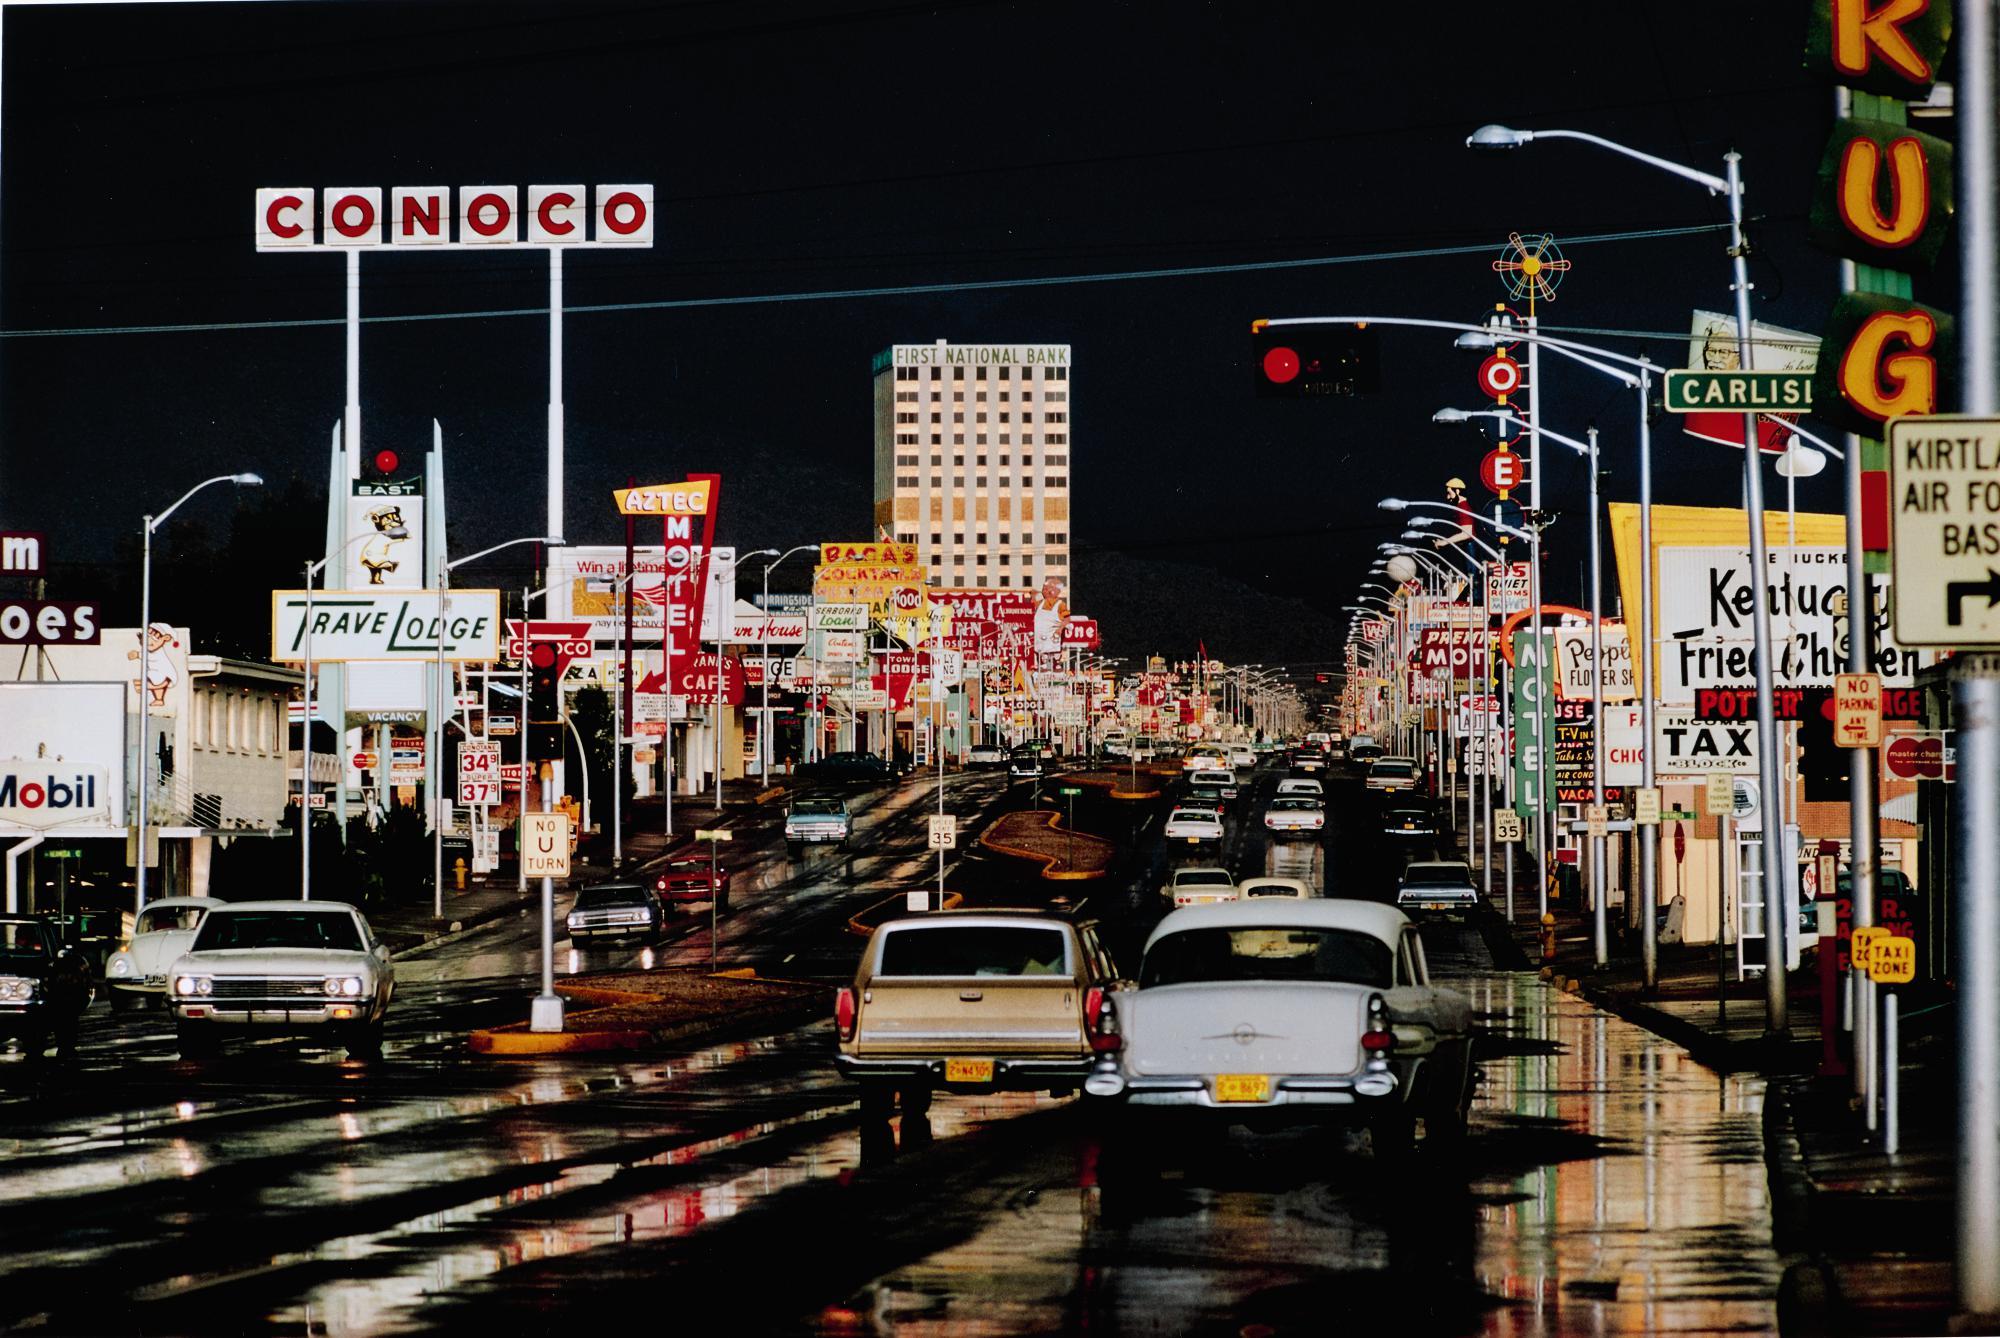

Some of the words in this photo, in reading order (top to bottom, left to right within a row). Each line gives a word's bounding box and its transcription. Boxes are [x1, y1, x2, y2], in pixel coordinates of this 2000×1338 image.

[266, 192, 647, 238] CONOCO
[896, 348, 938, 364] FIRST
[945, 348, 1020, 364] NATIONAL
[1027, 348, 1068, 364] BANK
[1906, 439, 2000, 471] KIRTL
[358, 486, 415, 495] EAST
[625, 490, 704, 512] AZTEC
[1903, 481, 1949, 514] AIR
[1943, 525, 2000, 556] BAS
[1746, 553, 1777, 564] TE
[577, 561, 603, 573] Win
[667, 516, 690, 656] MOTEL
[682, 674, 730, 690] CAFE
[1570, 669, 1616, 686] FLOER
[1848, 680, 1870, 693] NO
[684, 694, 728, 703] PIZZA
[1839, 698, 1877, 711] PARKING
[367, 712, 421, 721] VACANCY
[1668, 718, 1748, 726] INCOME
[1520, 643, 1549, 806] MOTEL
[1557, 728, 1579, 740] T-V
[1662, 728, 1752, 757] TAX
[0, 775, 95, 808] Mobil
[1558, 789, 1622, 800] VACACY
[536, 821, 556, 832] NO
[1498, 826, 1518, 838] 35
[538, 836, 553, 852] U
[932, 833, 952, 844] 35
[528, 858, 564, 868] TURN
[1874, 946, 1909, 957] TAXI
[1874, 962, 1909, 974] ZONE
